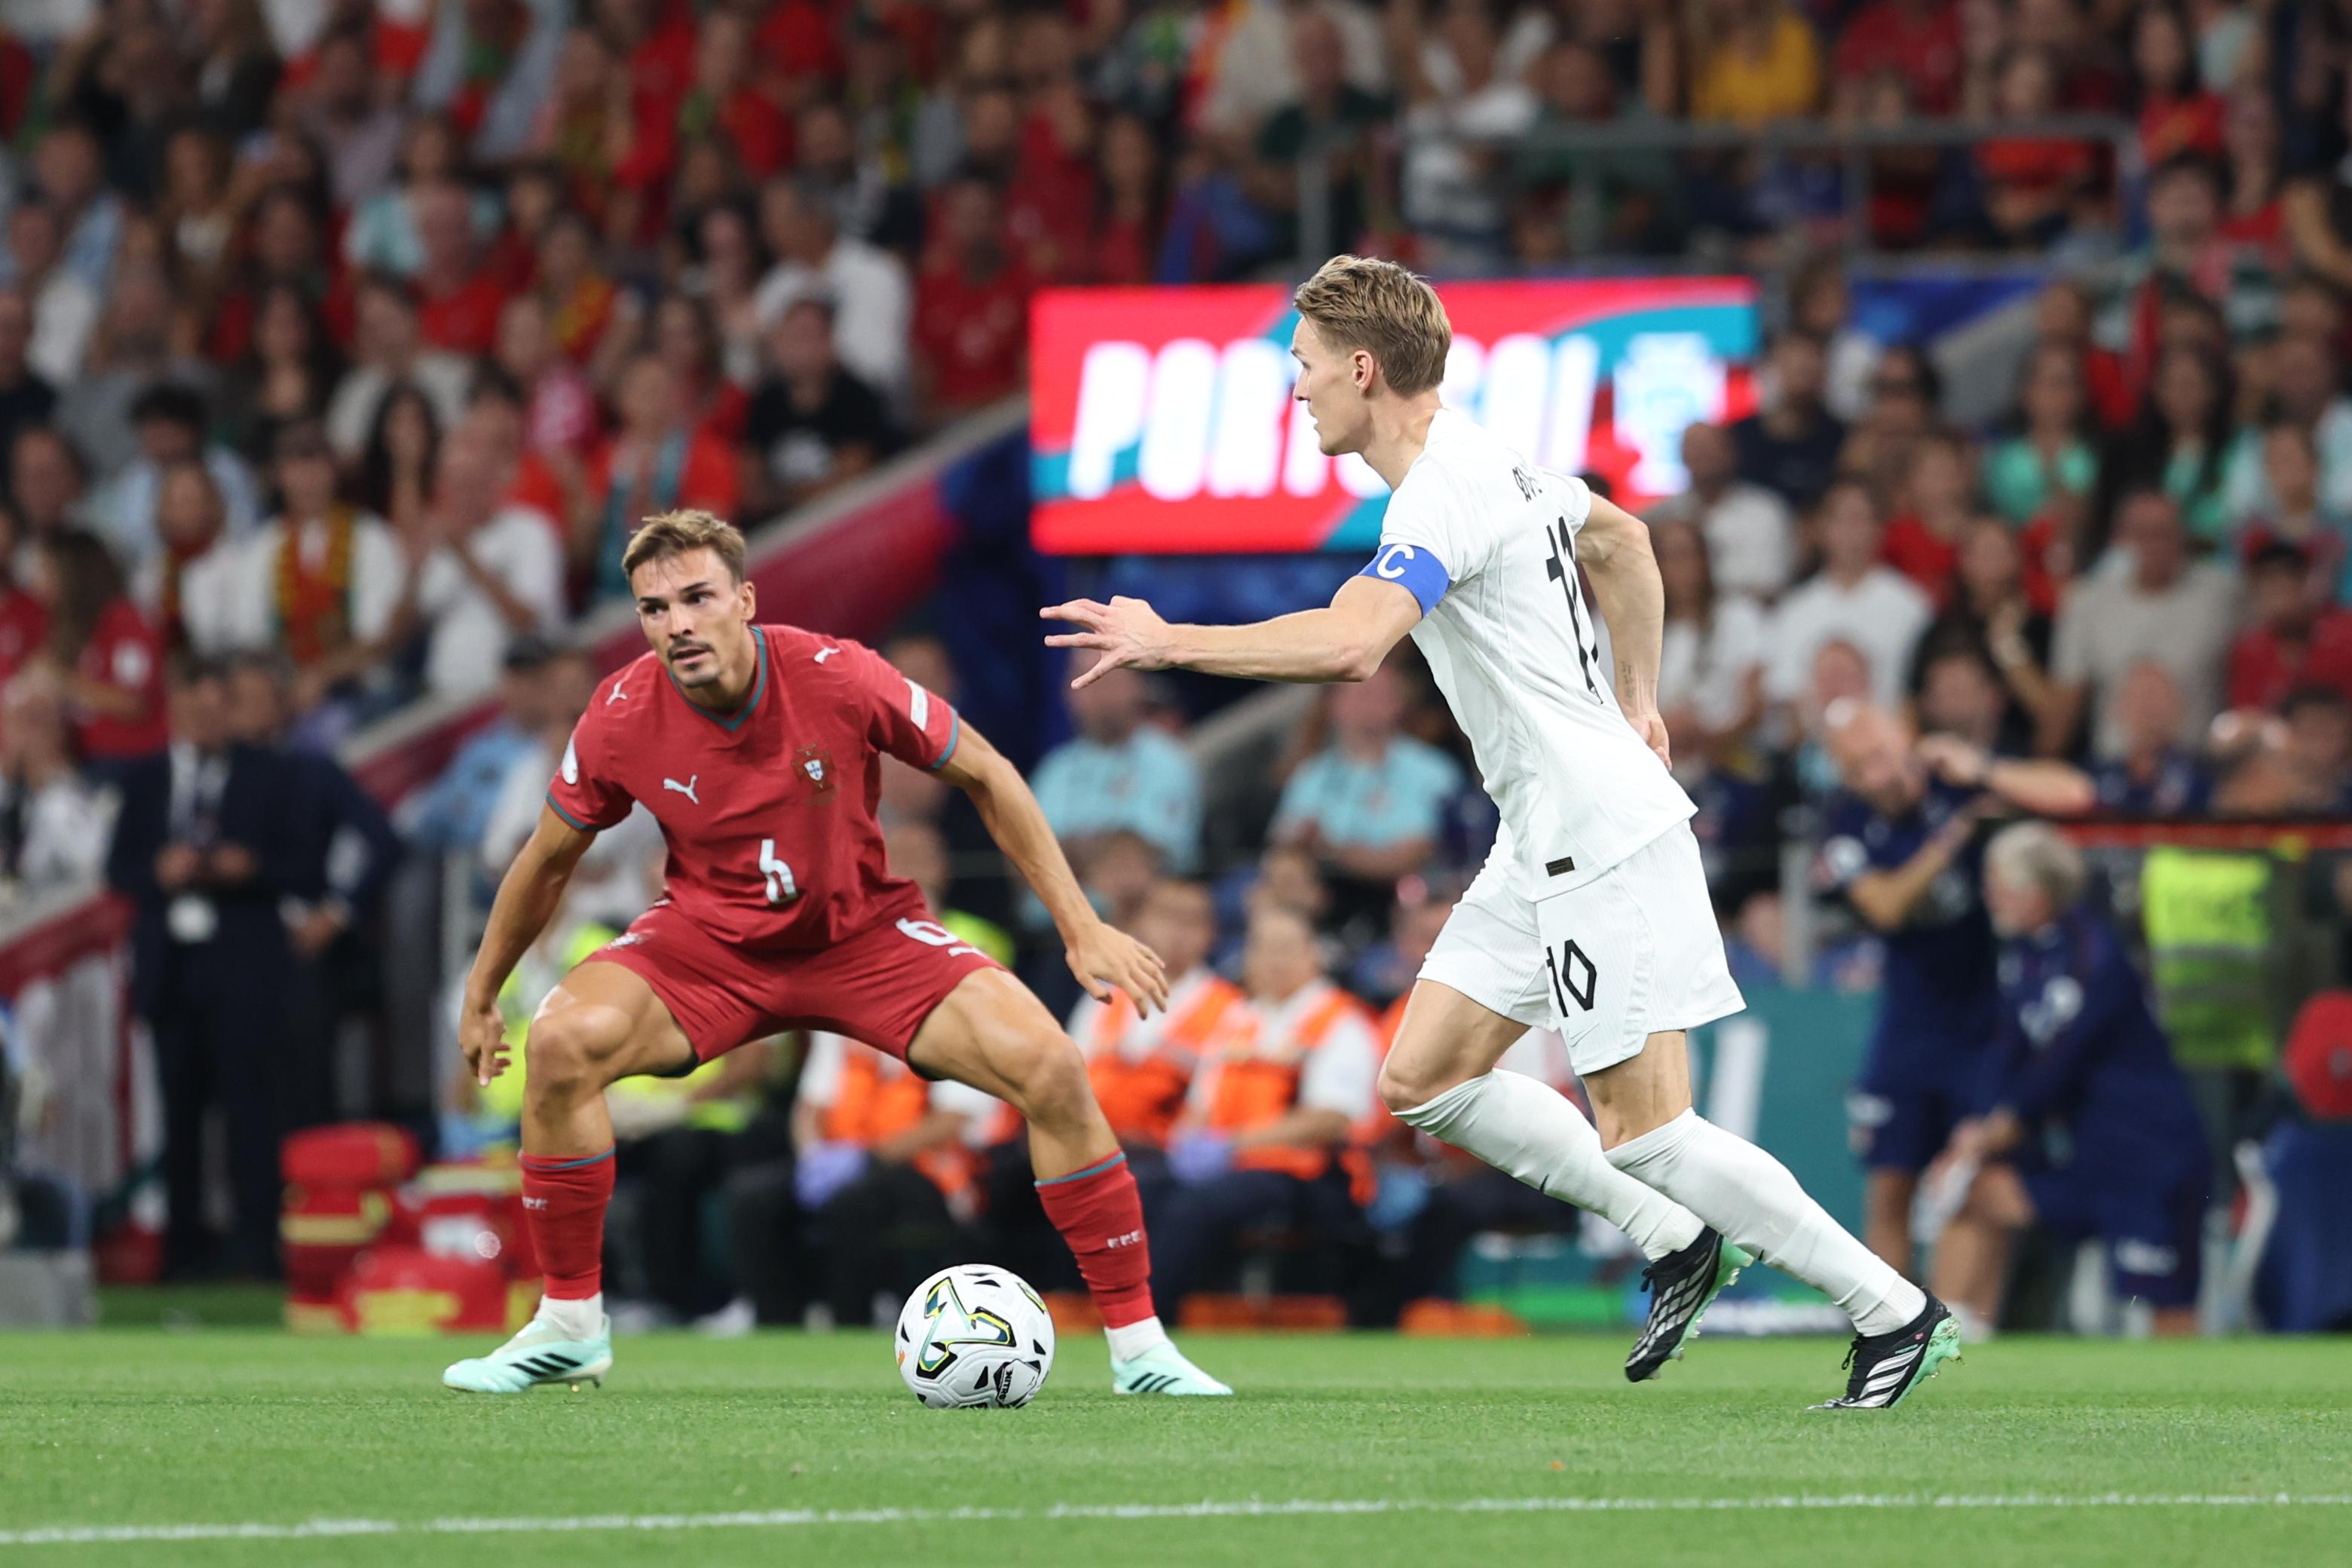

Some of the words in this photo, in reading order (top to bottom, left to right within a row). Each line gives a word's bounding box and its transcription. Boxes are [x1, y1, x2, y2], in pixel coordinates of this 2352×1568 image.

[1067, 335, 1600, 499] PORAL
[1377, 544, 1414, 579] C
[758, 838, 798, 903] 6
[895, 917, 960, 946] 6
[1545, 939, 1597, 1018] 10
